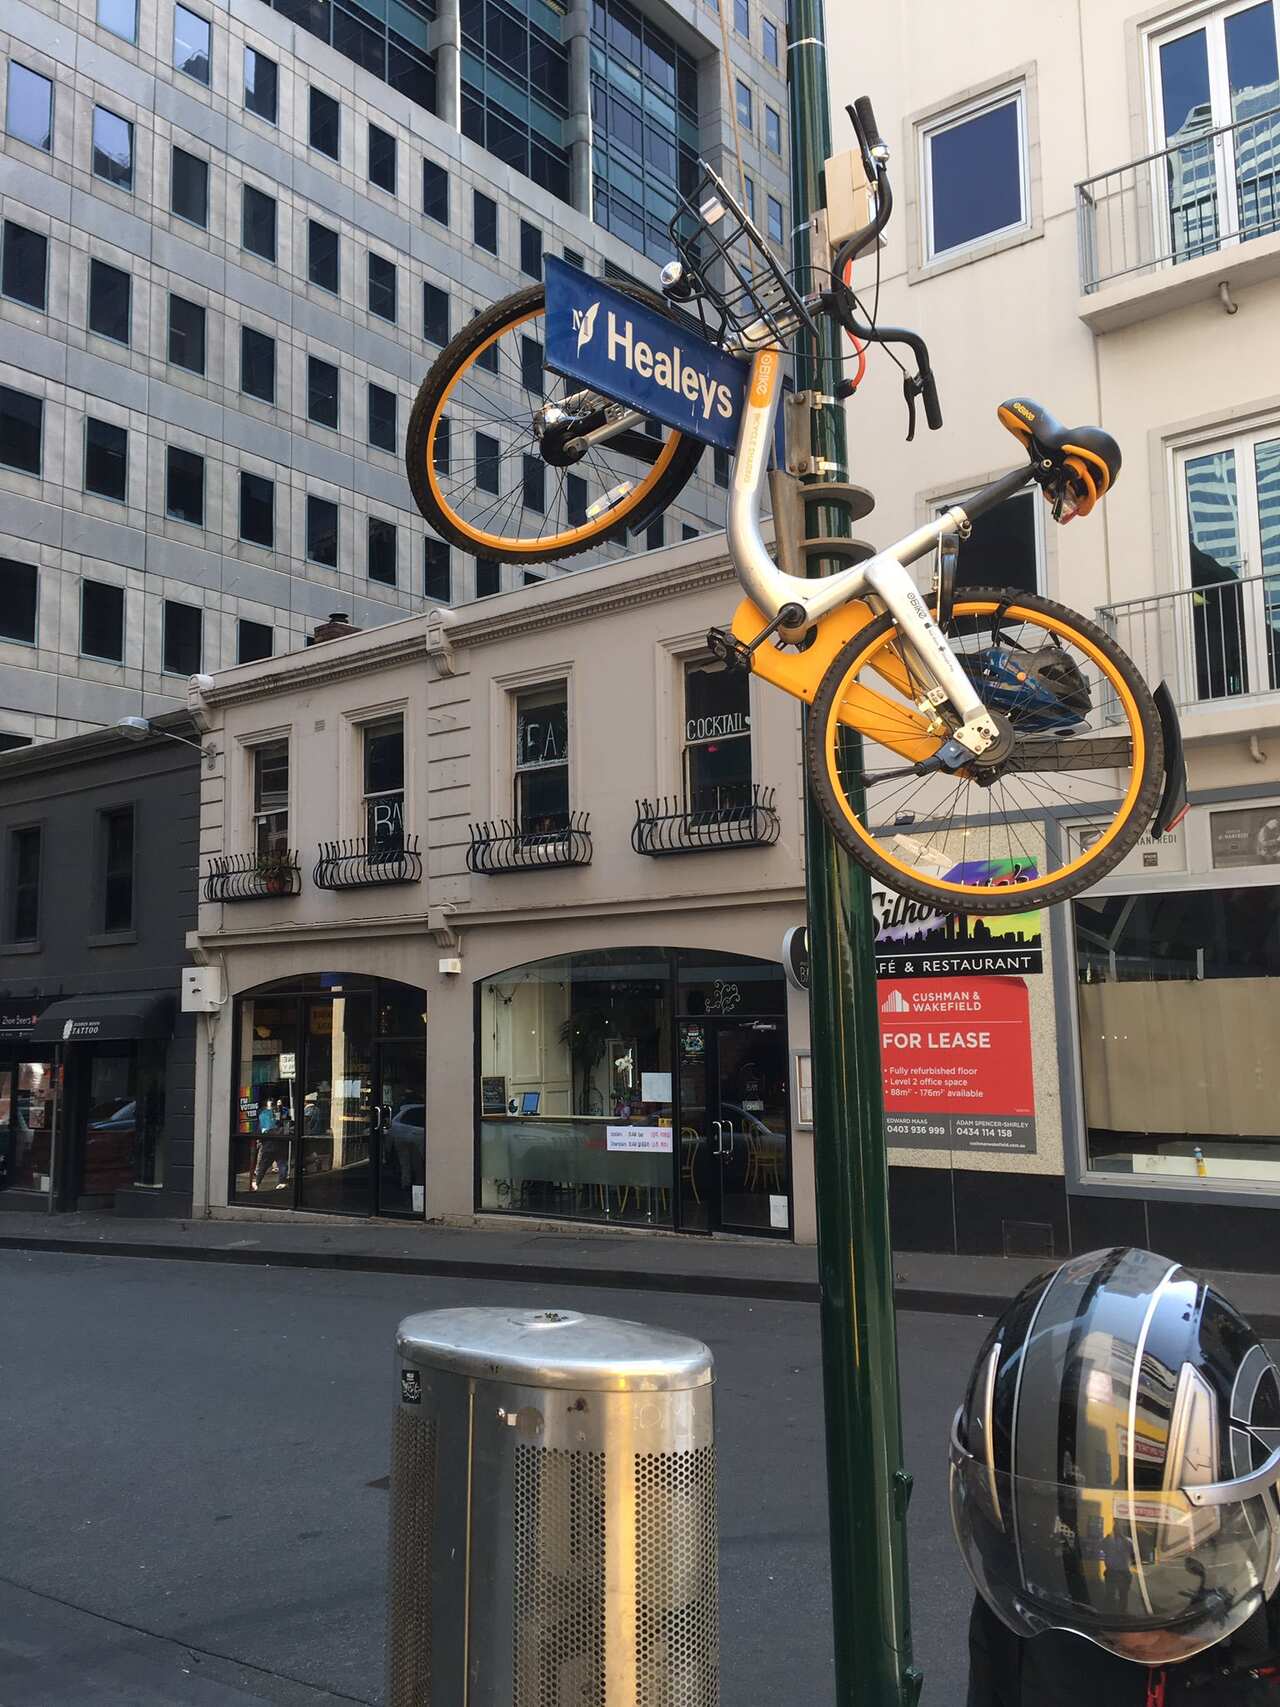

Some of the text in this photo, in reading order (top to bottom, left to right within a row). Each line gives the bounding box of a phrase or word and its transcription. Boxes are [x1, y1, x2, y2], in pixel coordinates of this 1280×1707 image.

[607, 311, 733, 420] Healeys
[904, 961, 914, 973] &
[922, 956, 1032, 973] RESTAURANT
[912, 991, 981, 1001] CUSHMAN &
[913, 1001, 982, 1012] WAKEFIELD
[72, 1026, 99, 1035] TATTOO
[882, 1032, 992, 1049] FOR LEASE
[889, 1066, 978, 1076] Fully refurbished floor
[890, 1078, 968, 1088] Level 2 office space
[947, 1089, 984, 1098] available
[956, 1119, 974, 1127] ADAM
[886, 1125, 945, 1135] 0403 936 999
[956, 1127, 1013, 1138] 0434 114 158
